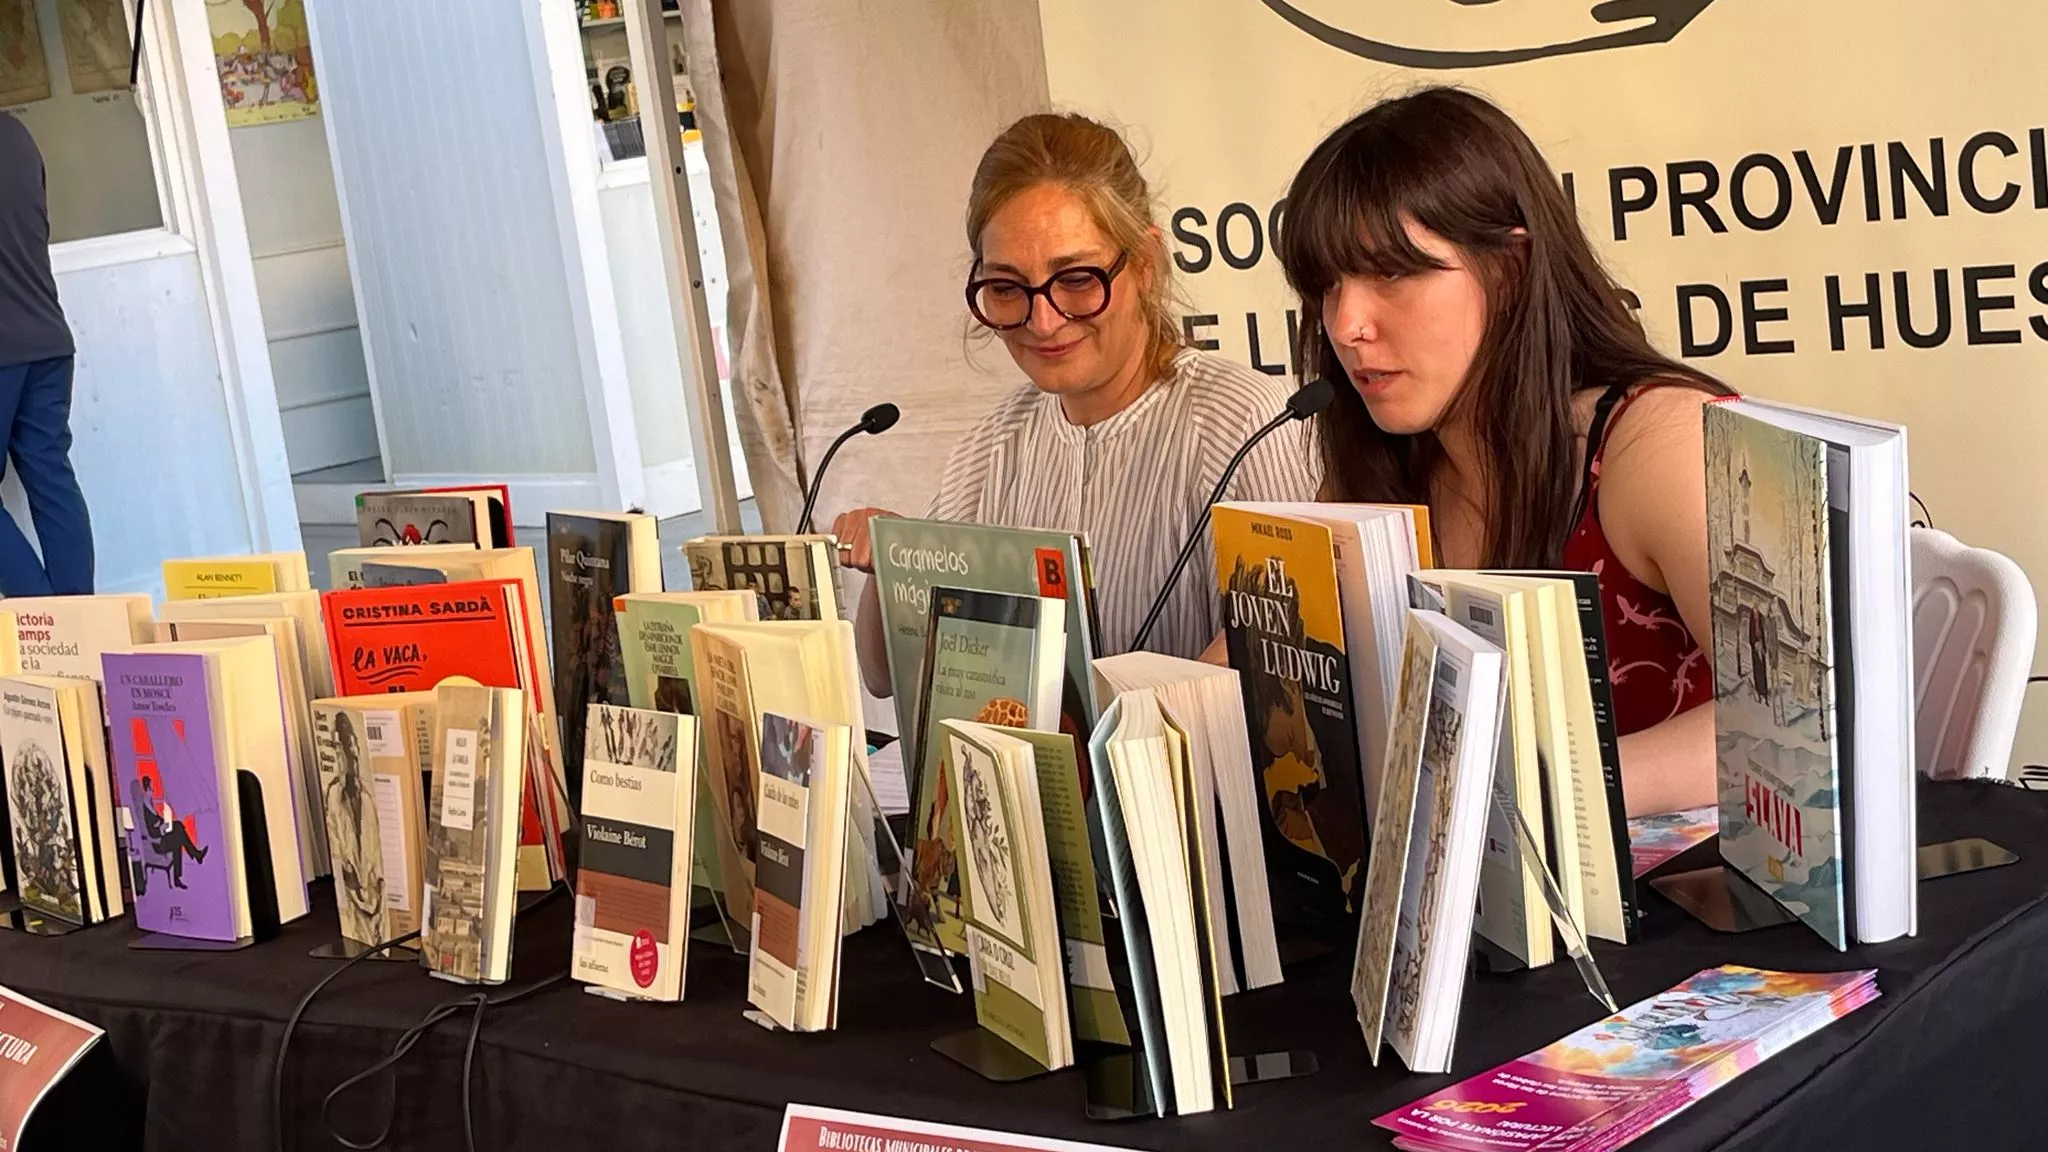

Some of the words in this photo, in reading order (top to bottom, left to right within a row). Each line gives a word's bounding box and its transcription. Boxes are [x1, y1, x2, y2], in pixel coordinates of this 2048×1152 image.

[1676, 278, 1795, 358] DE
[889, 543, 969, 576] Caramelos
[1043, 557, 1062, 585] B
[1265, 557, 1294, 599] EL
[342, 603, 424, 620] CRISTINA
[429, 594, 493, 615] SARDÀ
[893, 577, 931, 615] mági
[16, 612, 55, 626] ictoria
[1230, 590, 1291, 638] JOVEN
[18, 629, 51, 643] amps
[27, 641, 80, 656] sociedad
[31, 656, 41, 671] la
[1260, 638, 1341, 694] LUDWIG
[590, 769, 614, 786] Como
[615, 772, 642, 791] bestias
[586, 823, 622, 844] Violaine
[623, 830, 647, 848] Bérot
[0, 1031, 38, 1066] CTURA
